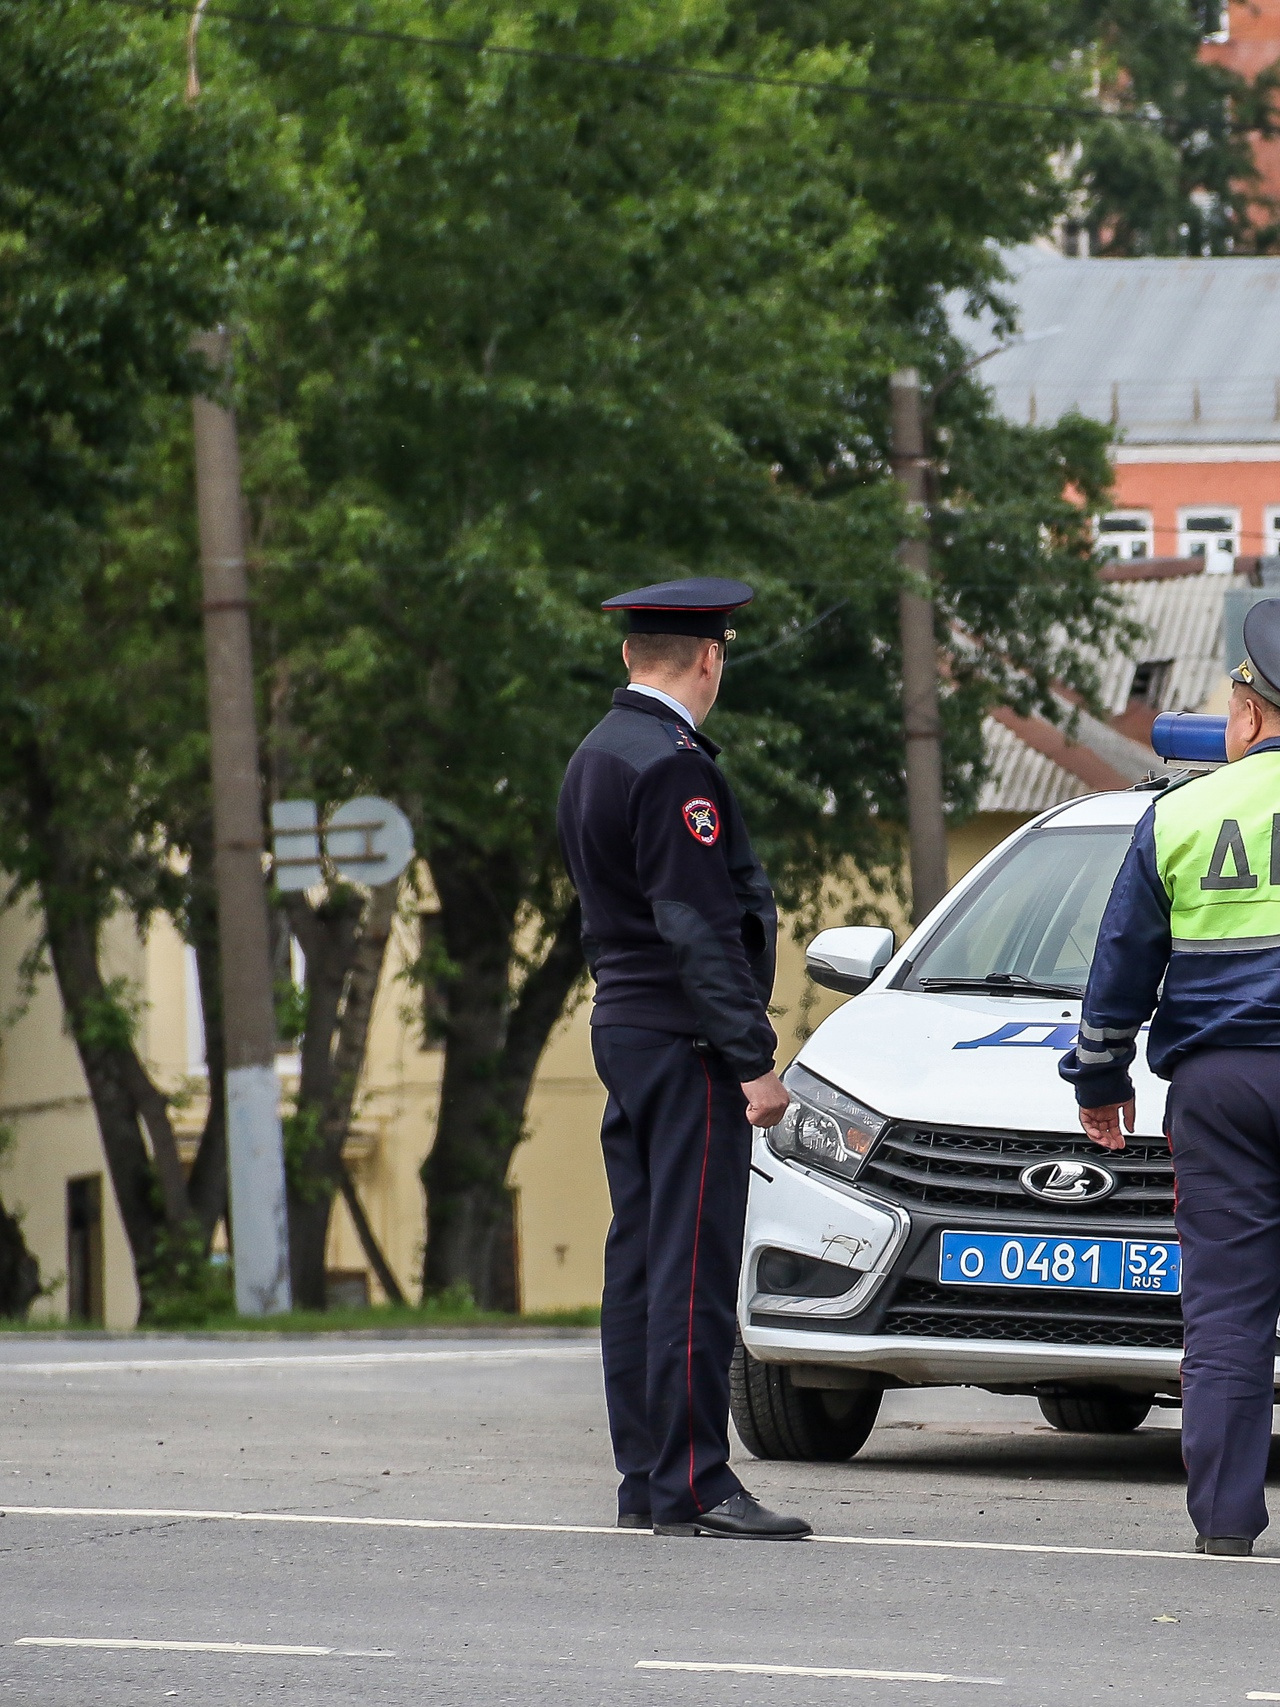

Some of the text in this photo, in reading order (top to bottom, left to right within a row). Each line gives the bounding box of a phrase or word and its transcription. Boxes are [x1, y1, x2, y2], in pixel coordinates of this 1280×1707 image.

[1001, 1240, 1100, 1284] 0481
[1128, 1244, 1168, 1276] 52
[1132, 1276, 1161, 1288] RUS
